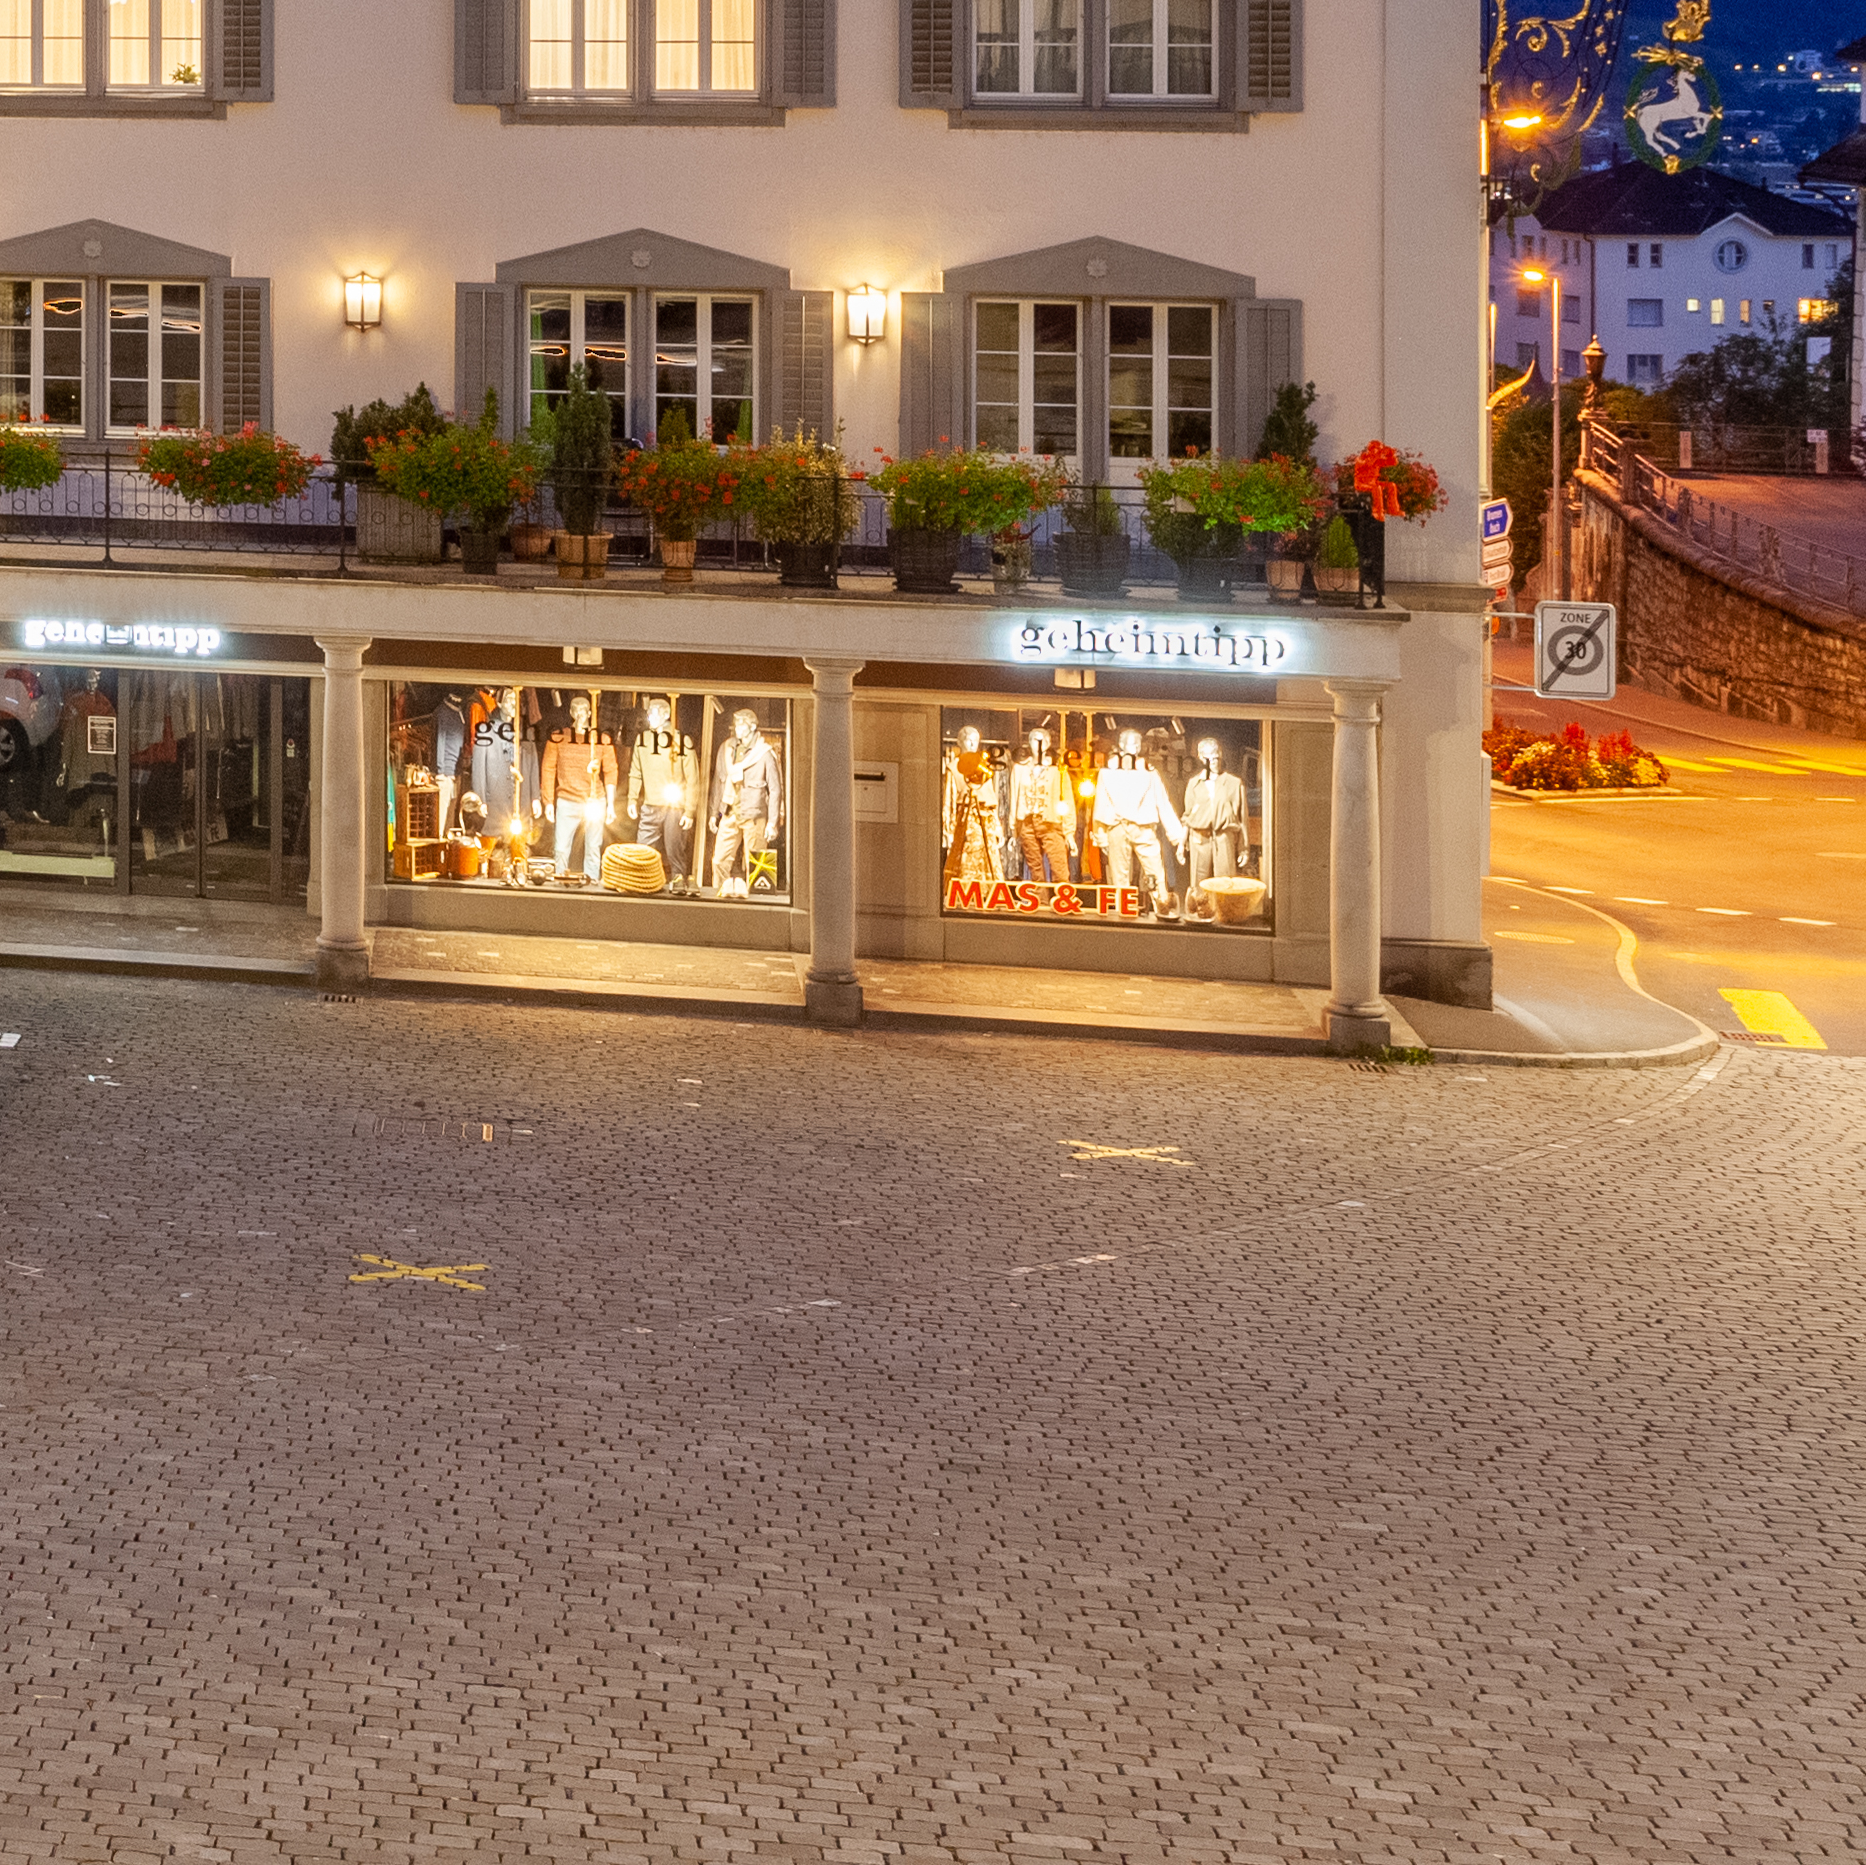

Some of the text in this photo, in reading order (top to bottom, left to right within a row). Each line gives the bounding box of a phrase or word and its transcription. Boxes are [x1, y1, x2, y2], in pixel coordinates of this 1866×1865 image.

[1560, 611, 1592, 624] ZONE
[1020, 619, 1286, 667] geheimtipp
[1564, 640, 1587, 660] 30
[948, 880, 1139, 916] MAS & FE
